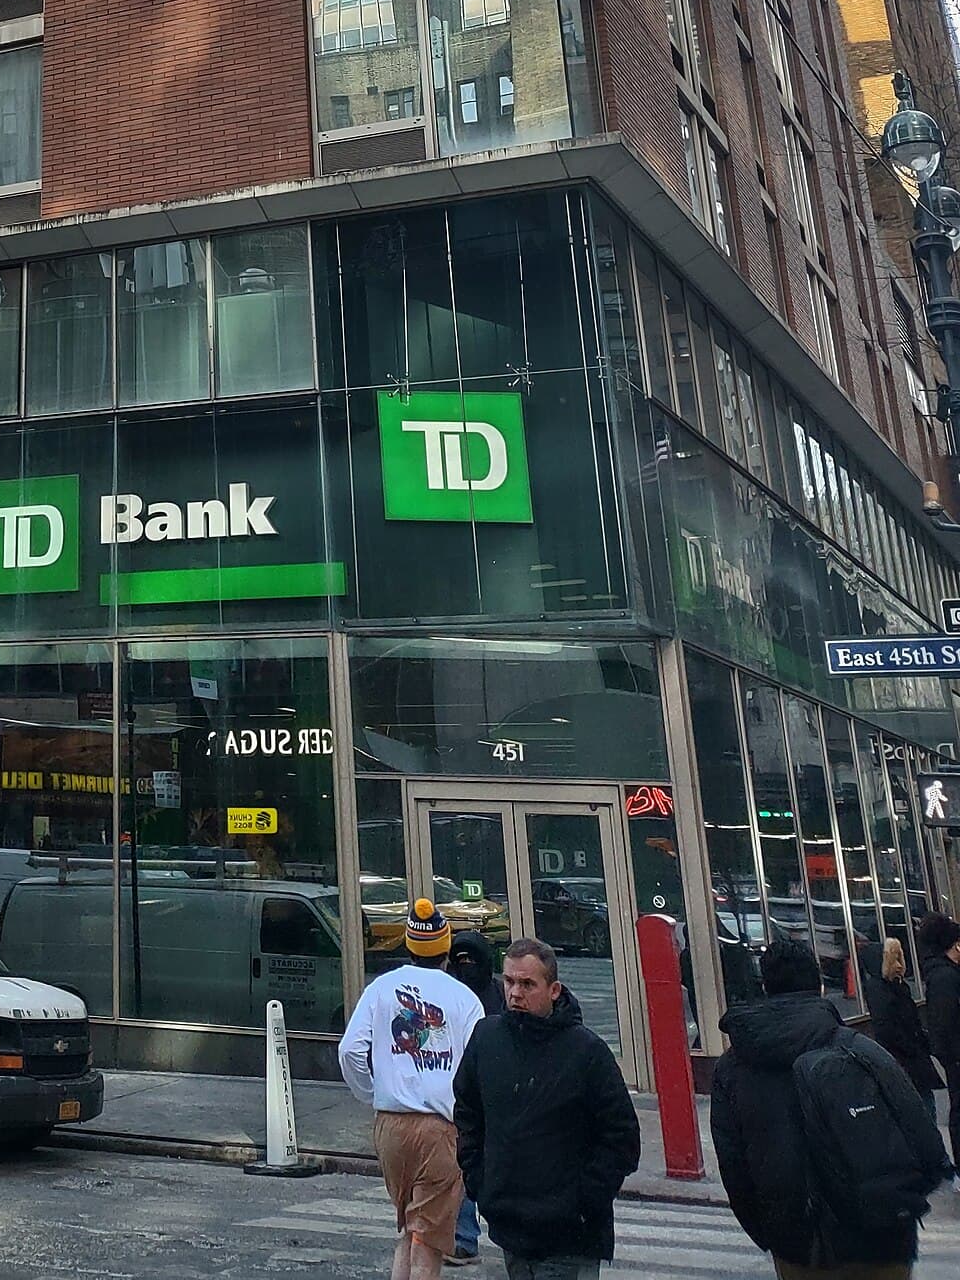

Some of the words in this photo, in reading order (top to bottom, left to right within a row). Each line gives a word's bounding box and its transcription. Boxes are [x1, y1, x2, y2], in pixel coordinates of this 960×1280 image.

[401, 420, 508, 491] TD
[100, 482, 279, 545] Bank
[836, 648, 884, 667] East
[889, 646, 936, 666] 45th
[492, 742, 524, 762] 451
[465, 883, 482, 897] TD
